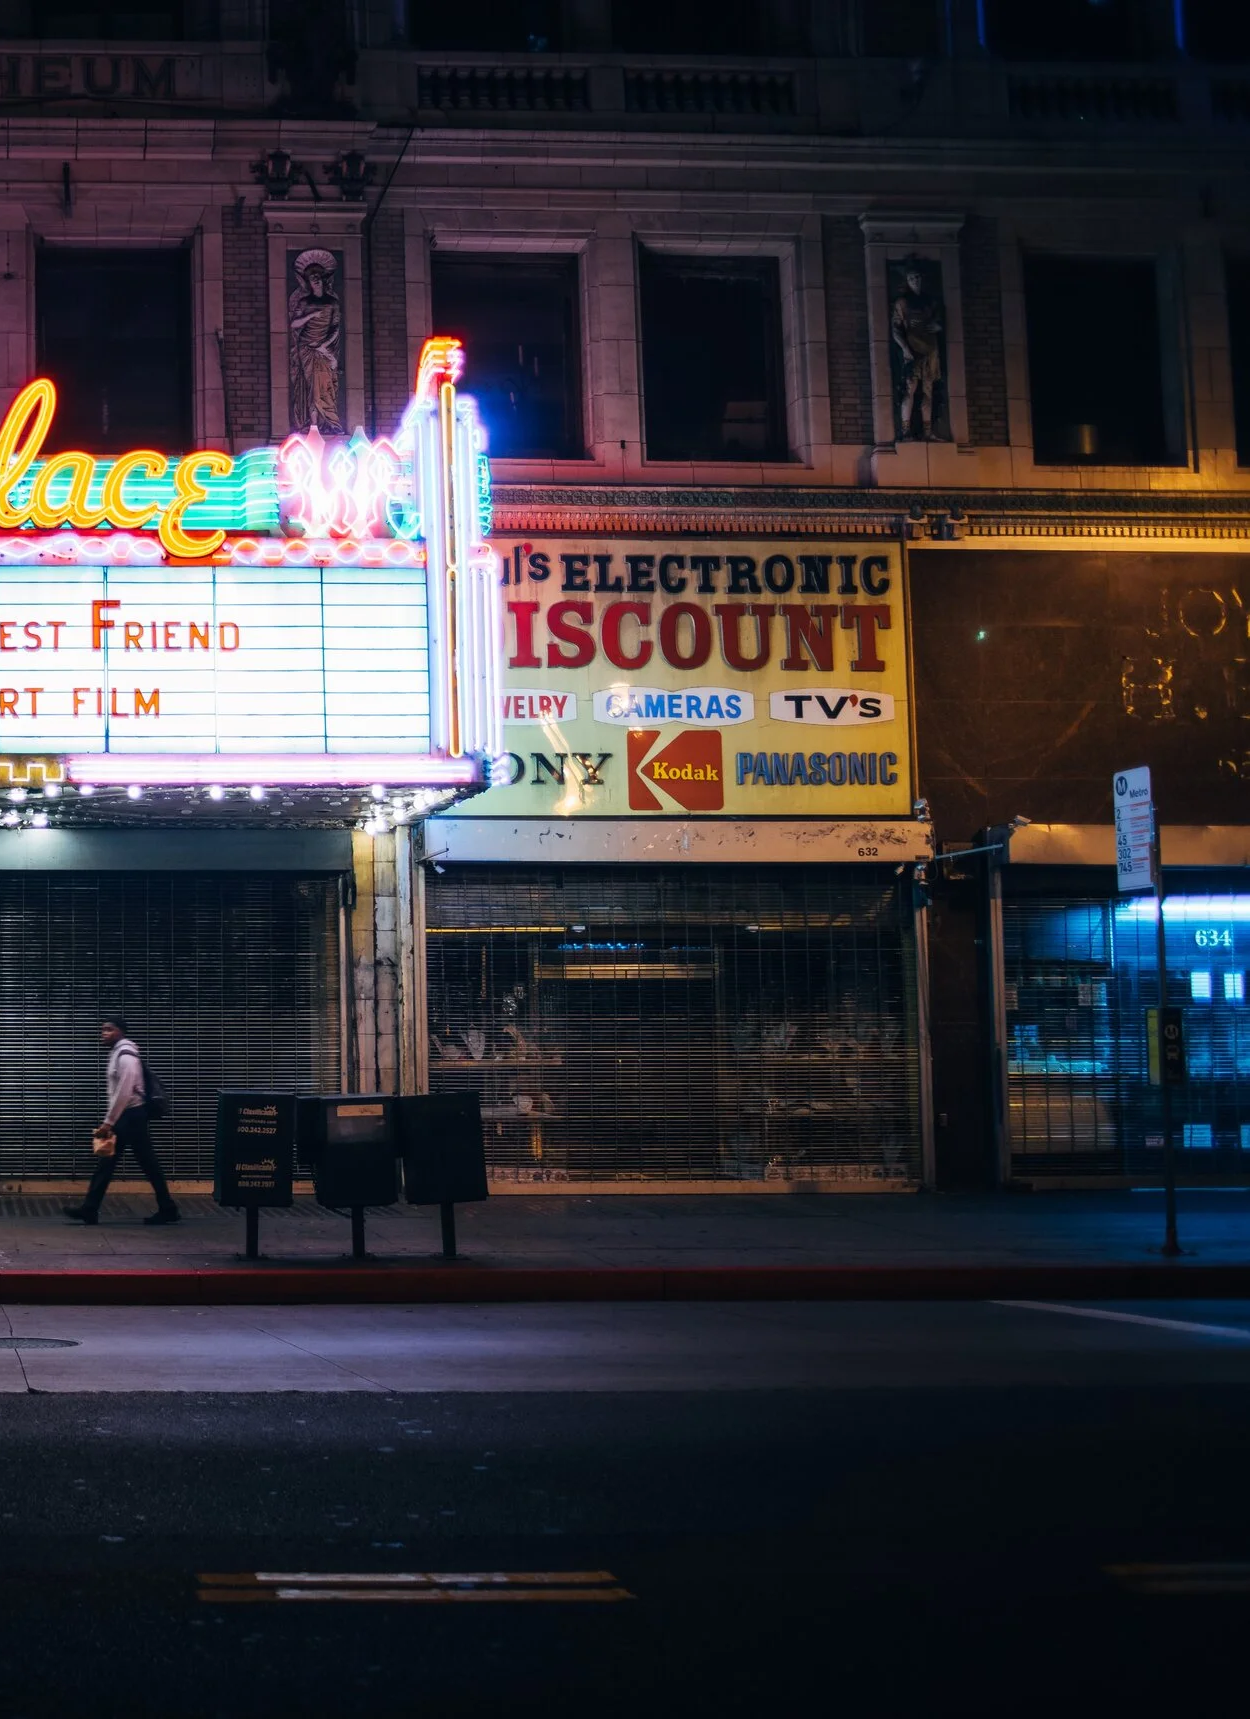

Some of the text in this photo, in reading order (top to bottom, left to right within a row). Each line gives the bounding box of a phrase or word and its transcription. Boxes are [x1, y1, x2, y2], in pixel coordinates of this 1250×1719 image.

[559, 553, 892, 595] ELECTRONIC
[506, 600, 893, 672] ISCOUNT
[72, 687, 161, 719] FILM
[605, 693, 741, 720] CAMERAS
[652, 761, 719, 782] Kodak
[736, 752, 898, 787] PANASONIC
[1129, 788, 1149, 798] Metro
[1116, 808, 1121, 820] 2
[1117, 835, 1127, 846] 45
[858, 847, 878, 857] 632
[1118, 848, 1131, 860] 302
[1119, 861, 1132, 873] 745
[1195, 929, 1231, 947] 634
